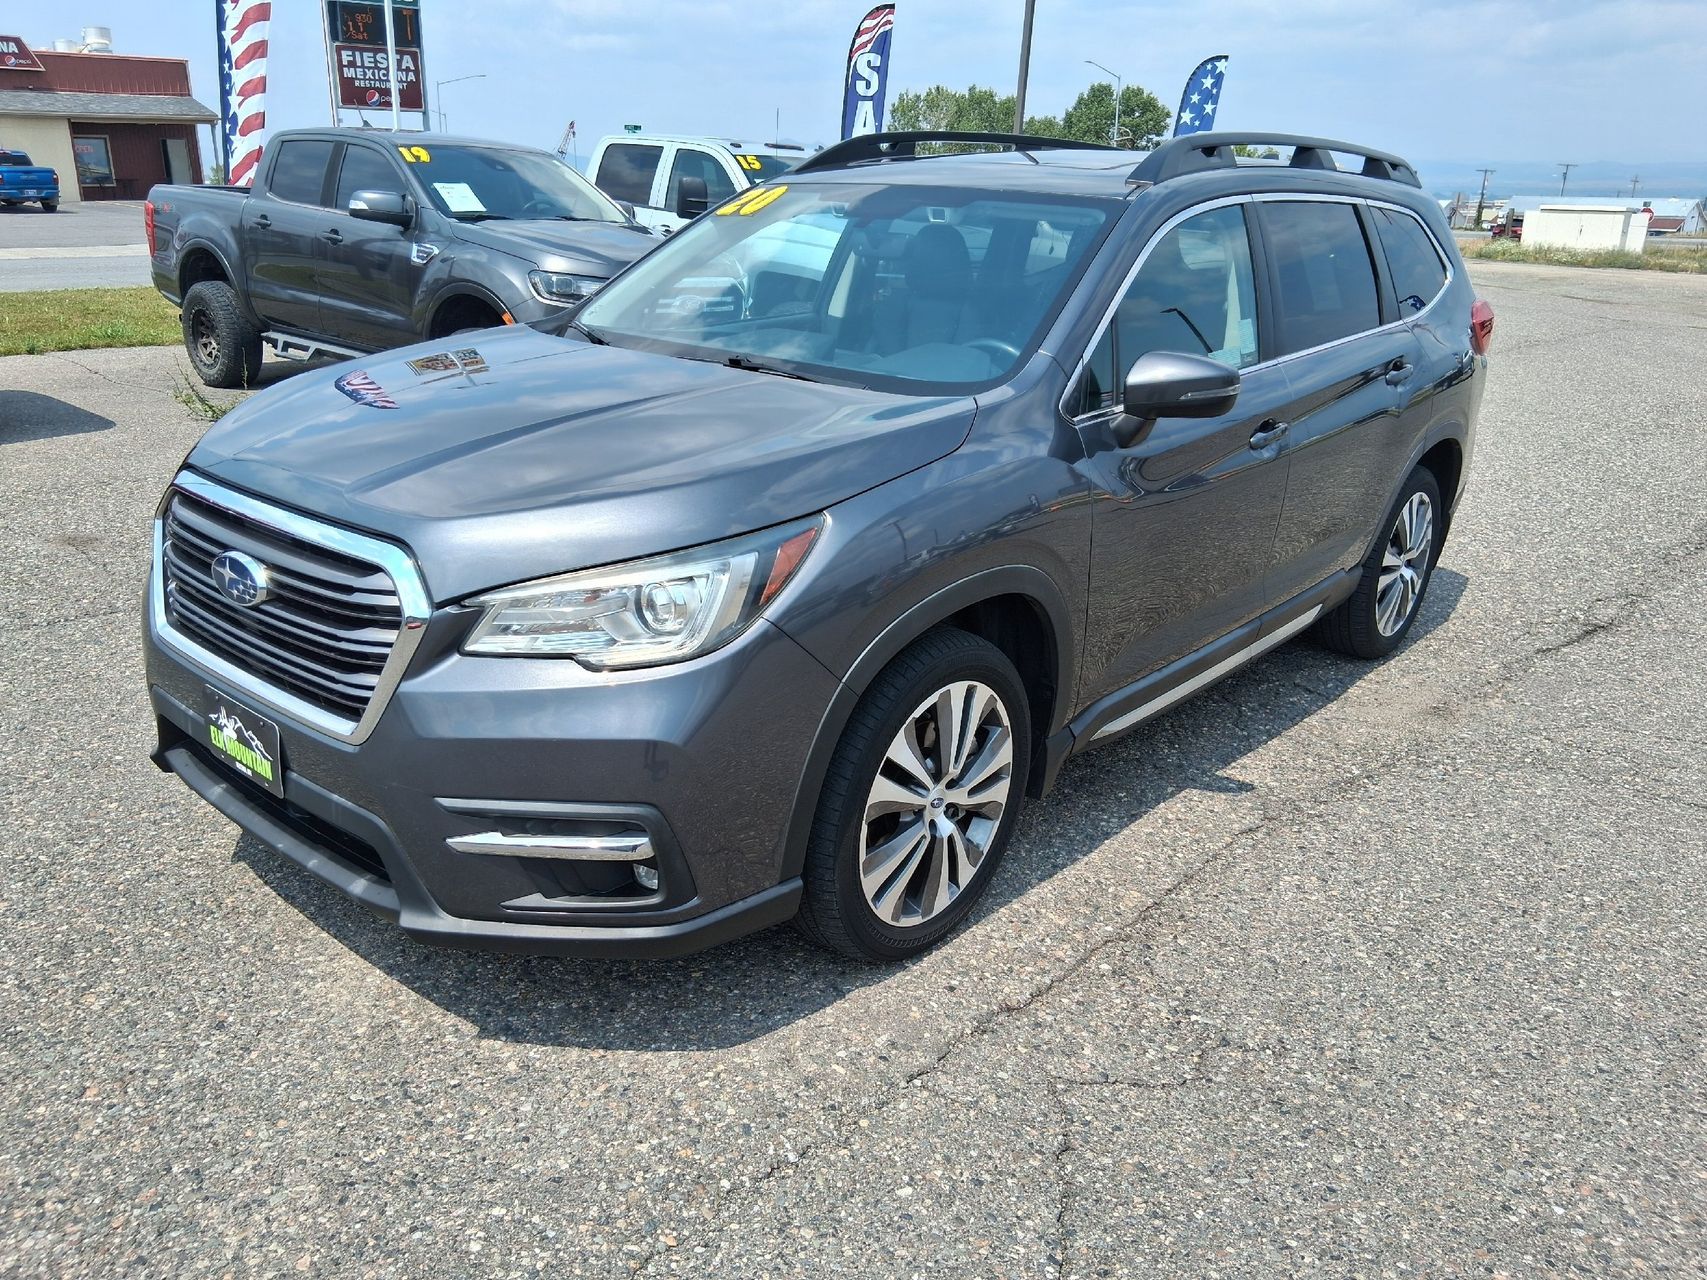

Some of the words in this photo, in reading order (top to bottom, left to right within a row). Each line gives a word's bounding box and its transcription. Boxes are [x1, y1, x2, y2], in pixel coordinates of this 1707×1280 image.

[343, 67, 416, 82] MEXICNA
[354, 80, 407, 90] RESTAURNT
[398, 146, 431, 163] 19
[735, 155, 762, 170] 15
[715, 185, 788, 216] 20
[226, 734, 273, 782] MOUNTAIN
